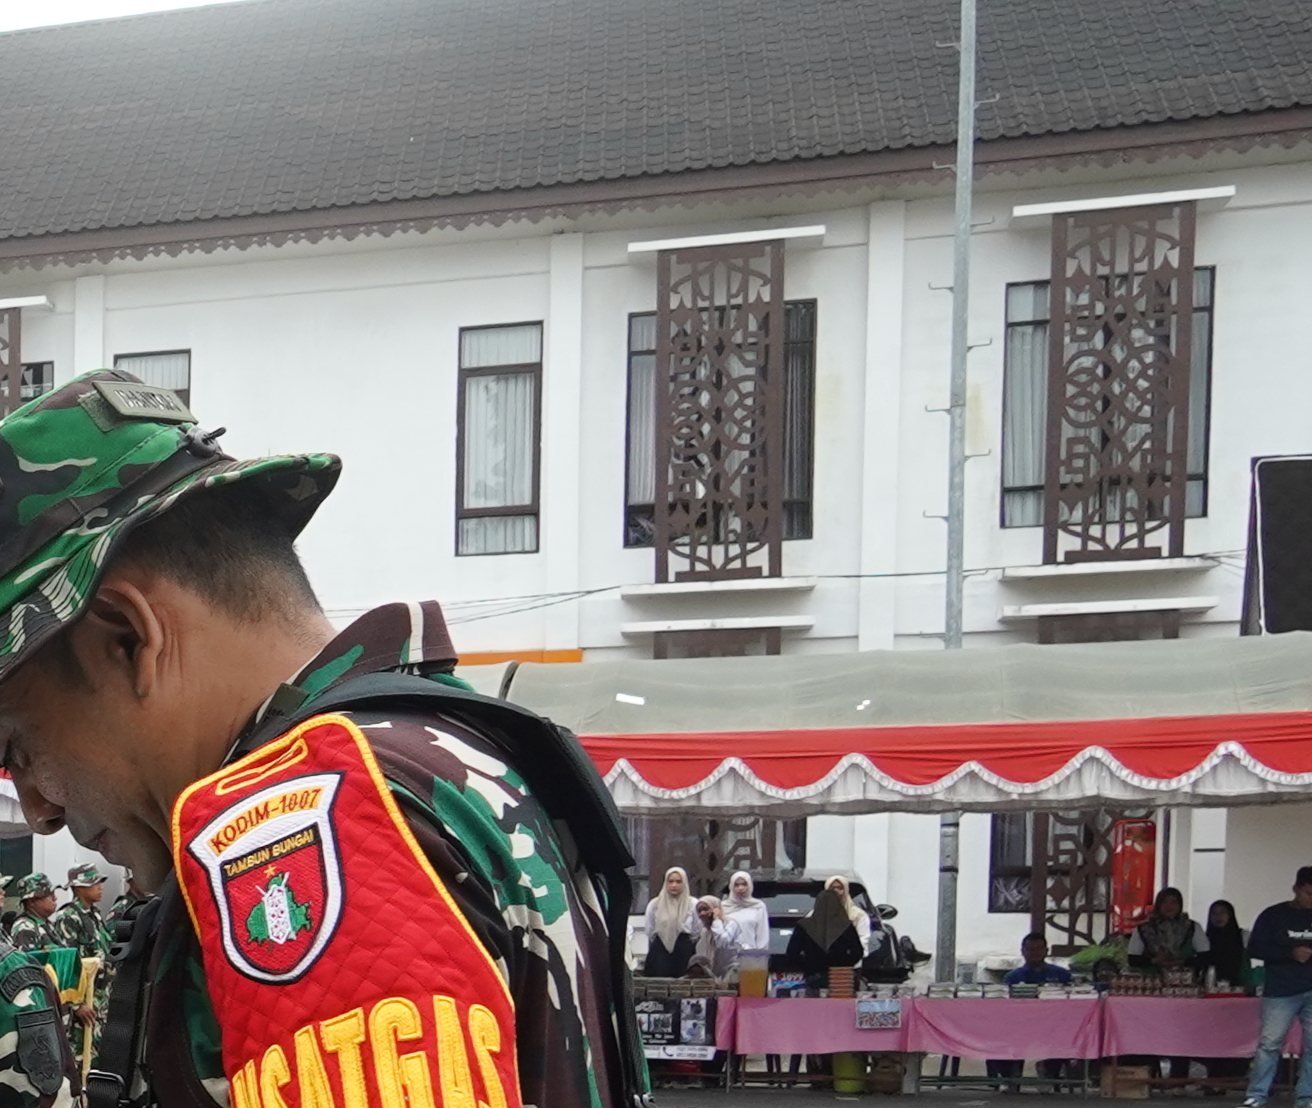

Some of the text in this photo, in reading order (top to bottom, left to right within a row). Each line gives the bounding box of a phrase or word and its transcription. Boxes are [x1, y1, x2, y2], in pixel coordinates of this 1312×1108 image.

[210, 788, 322, 854] KODIM-1007
[223, 828, 315, 876] TAMBUN BUNGAI
